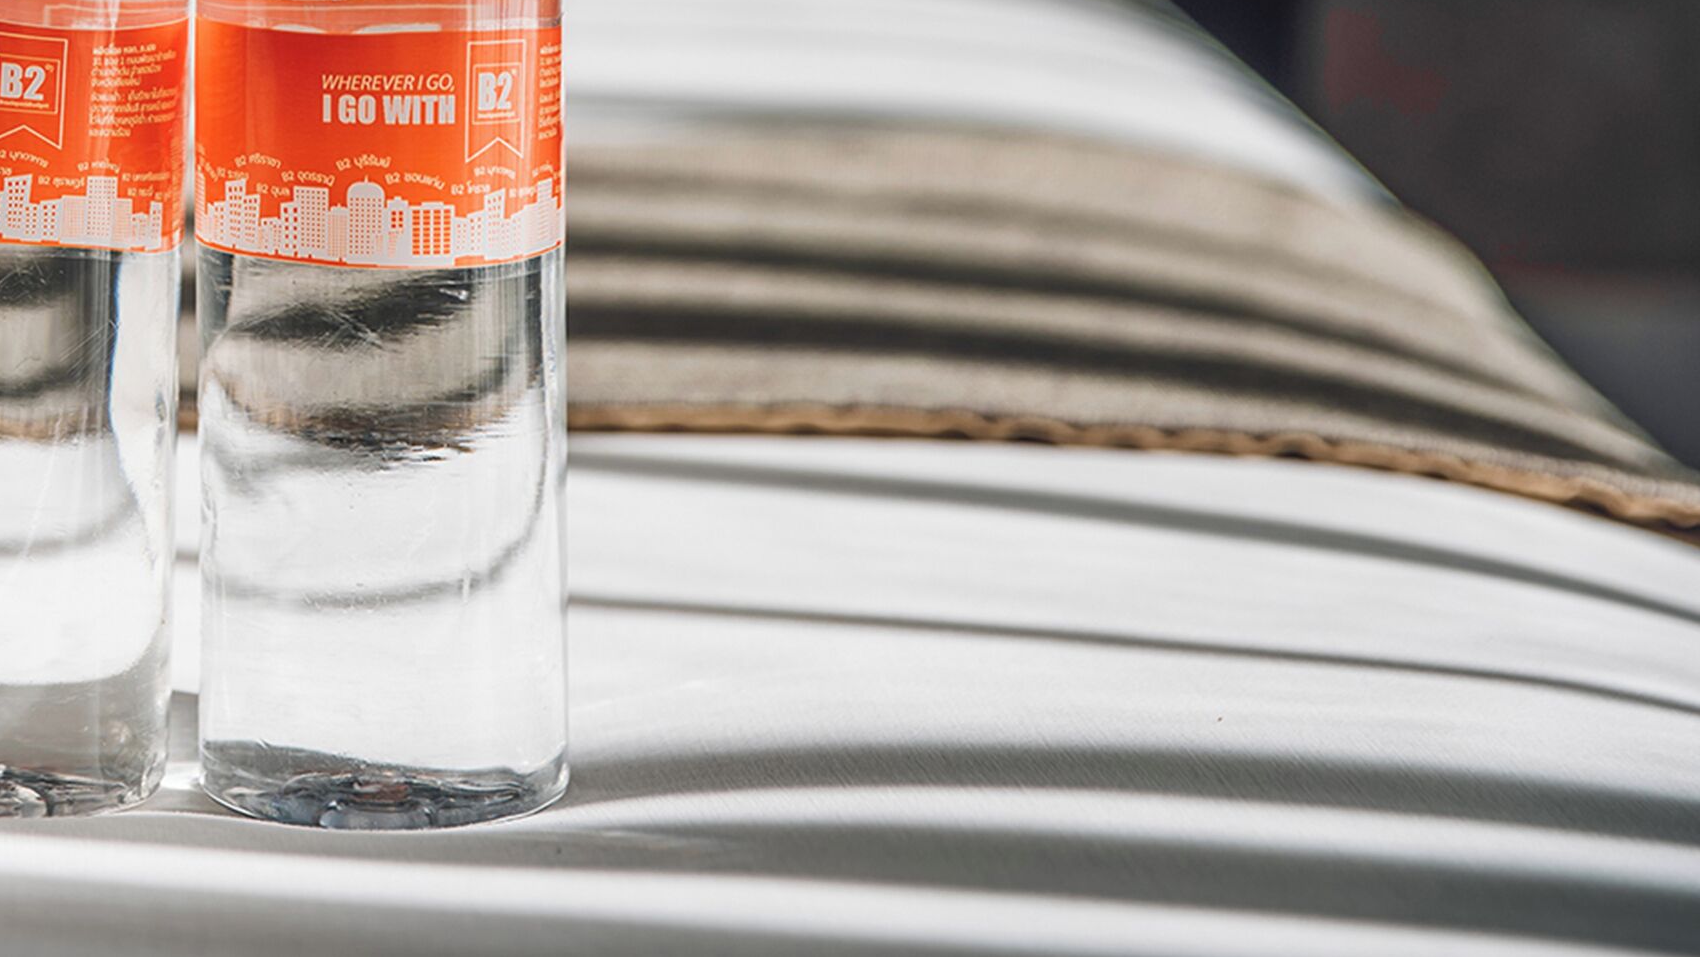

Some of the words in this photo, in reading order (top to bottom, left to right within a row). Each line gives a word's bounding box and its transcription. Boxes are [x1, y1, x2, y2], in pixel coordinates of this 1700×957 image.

[0, 62, 46, 101] B2
[322, 74, 415, 91] WHEREVER
[416, 74, 424, 91] I
[426, 73, 455, 93] GO,
[478, 72, 513, 111] B2
[322, 93, 332, 123] I
[338, 94, 376, 125] GO
[382, 94, 456, 125] WITH
